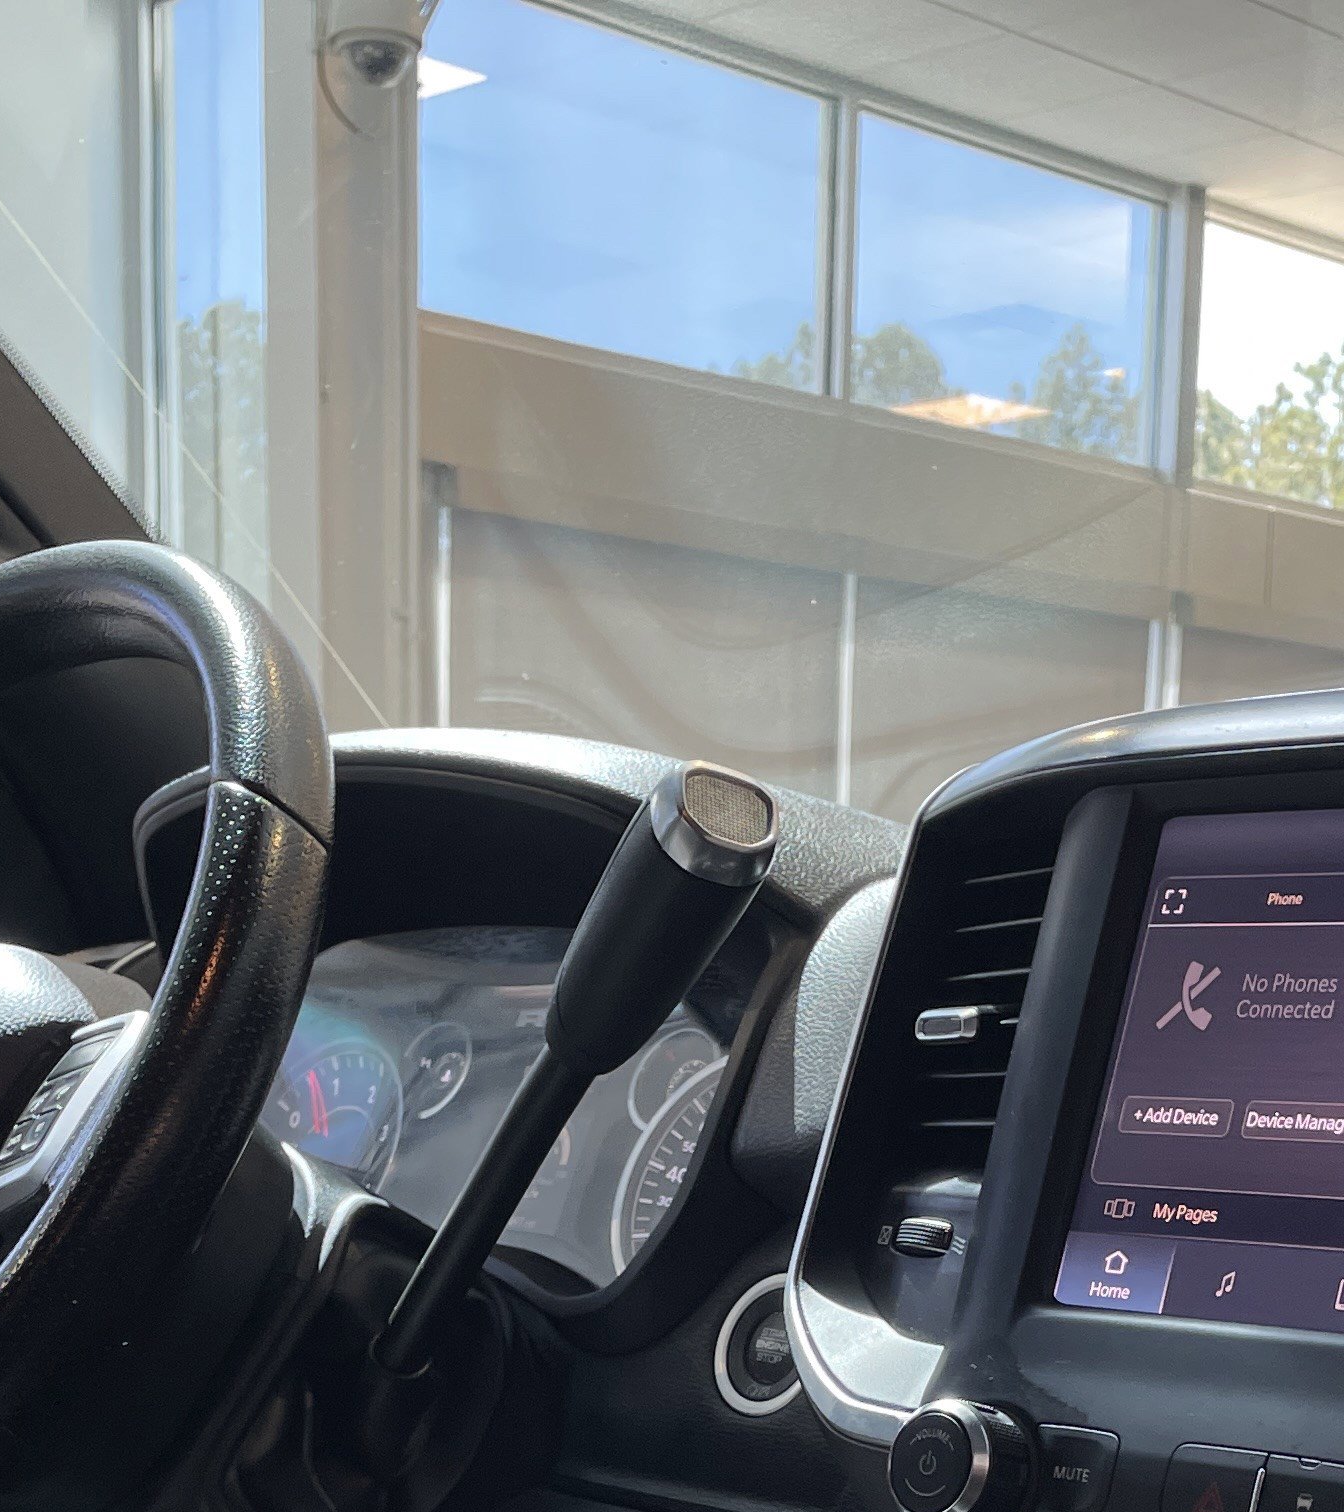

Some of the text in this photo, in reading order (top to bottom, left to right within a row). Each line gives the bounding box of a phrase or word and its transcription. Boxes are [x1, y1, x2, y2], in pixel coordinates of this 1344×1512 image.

[1266, 892, 1304, 906] Phone
[1242, 973, 1338, 993] No Phones
[1236, 999, 1335, 1019] Connected
[1173, 1109, 1219, 1126] Device
[1246, 1111, 1293, 1129] Device
[1152, 1203, 1219, 1225] My Pages
[1089, 1281, 1130, 1300] Home
[1053, 1465, 1090, 1483] MUTE
